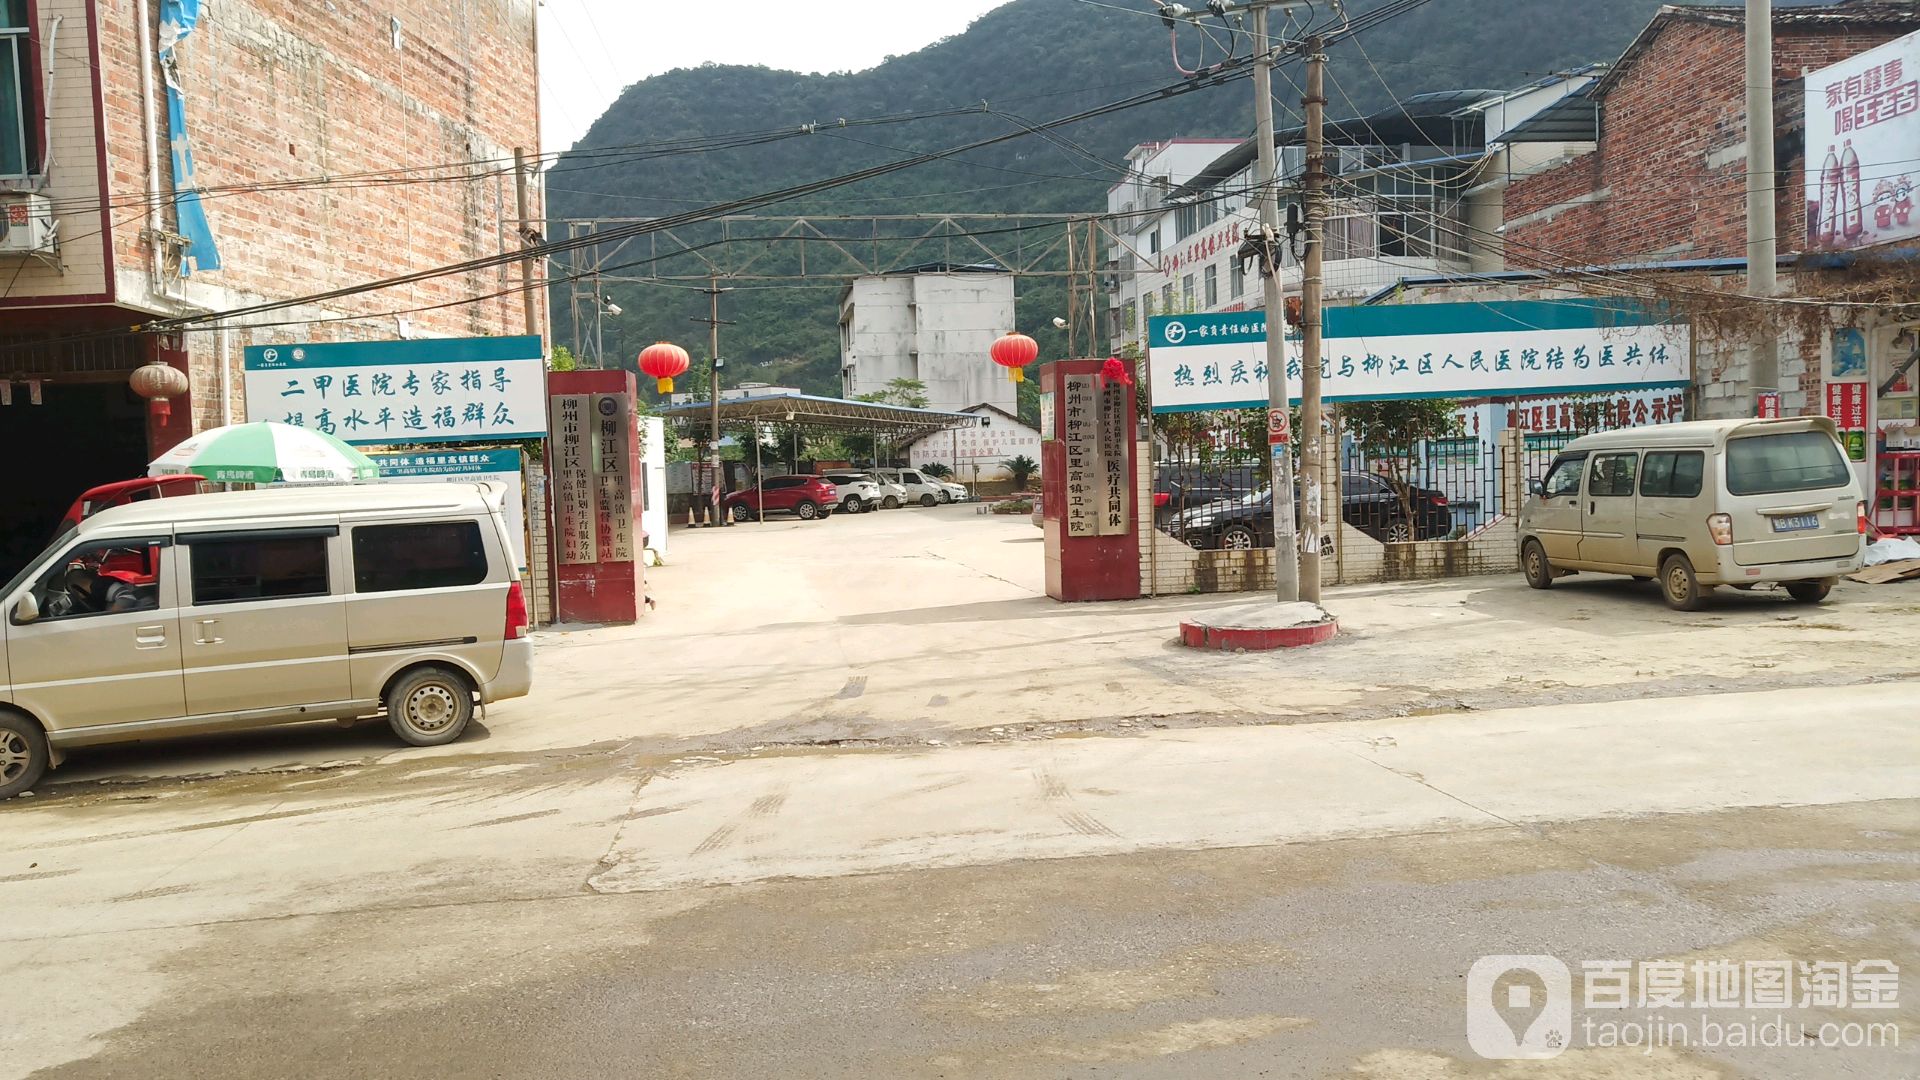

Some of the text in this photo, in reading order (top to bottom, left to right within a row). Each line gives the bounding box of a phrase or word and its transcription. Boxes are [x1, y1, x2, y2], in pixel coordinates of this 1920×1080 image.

[1834, 80, 1919, 136] 喝王老吉
[280, 366, 512, 400] 二甲医院专家指导
[283, 401, 515, 436] 提高水平造福群众
[1832, 384, 1842, 426] 健康过节
[1851, 384, 1862, 426] 健康过节
[374, 458, 410, 467] 共同体
[1066, 381, 1085, 532] 柳州市柳江区里高镇卫生院
[1107, 460, 1121, 527] 医疗共同体
